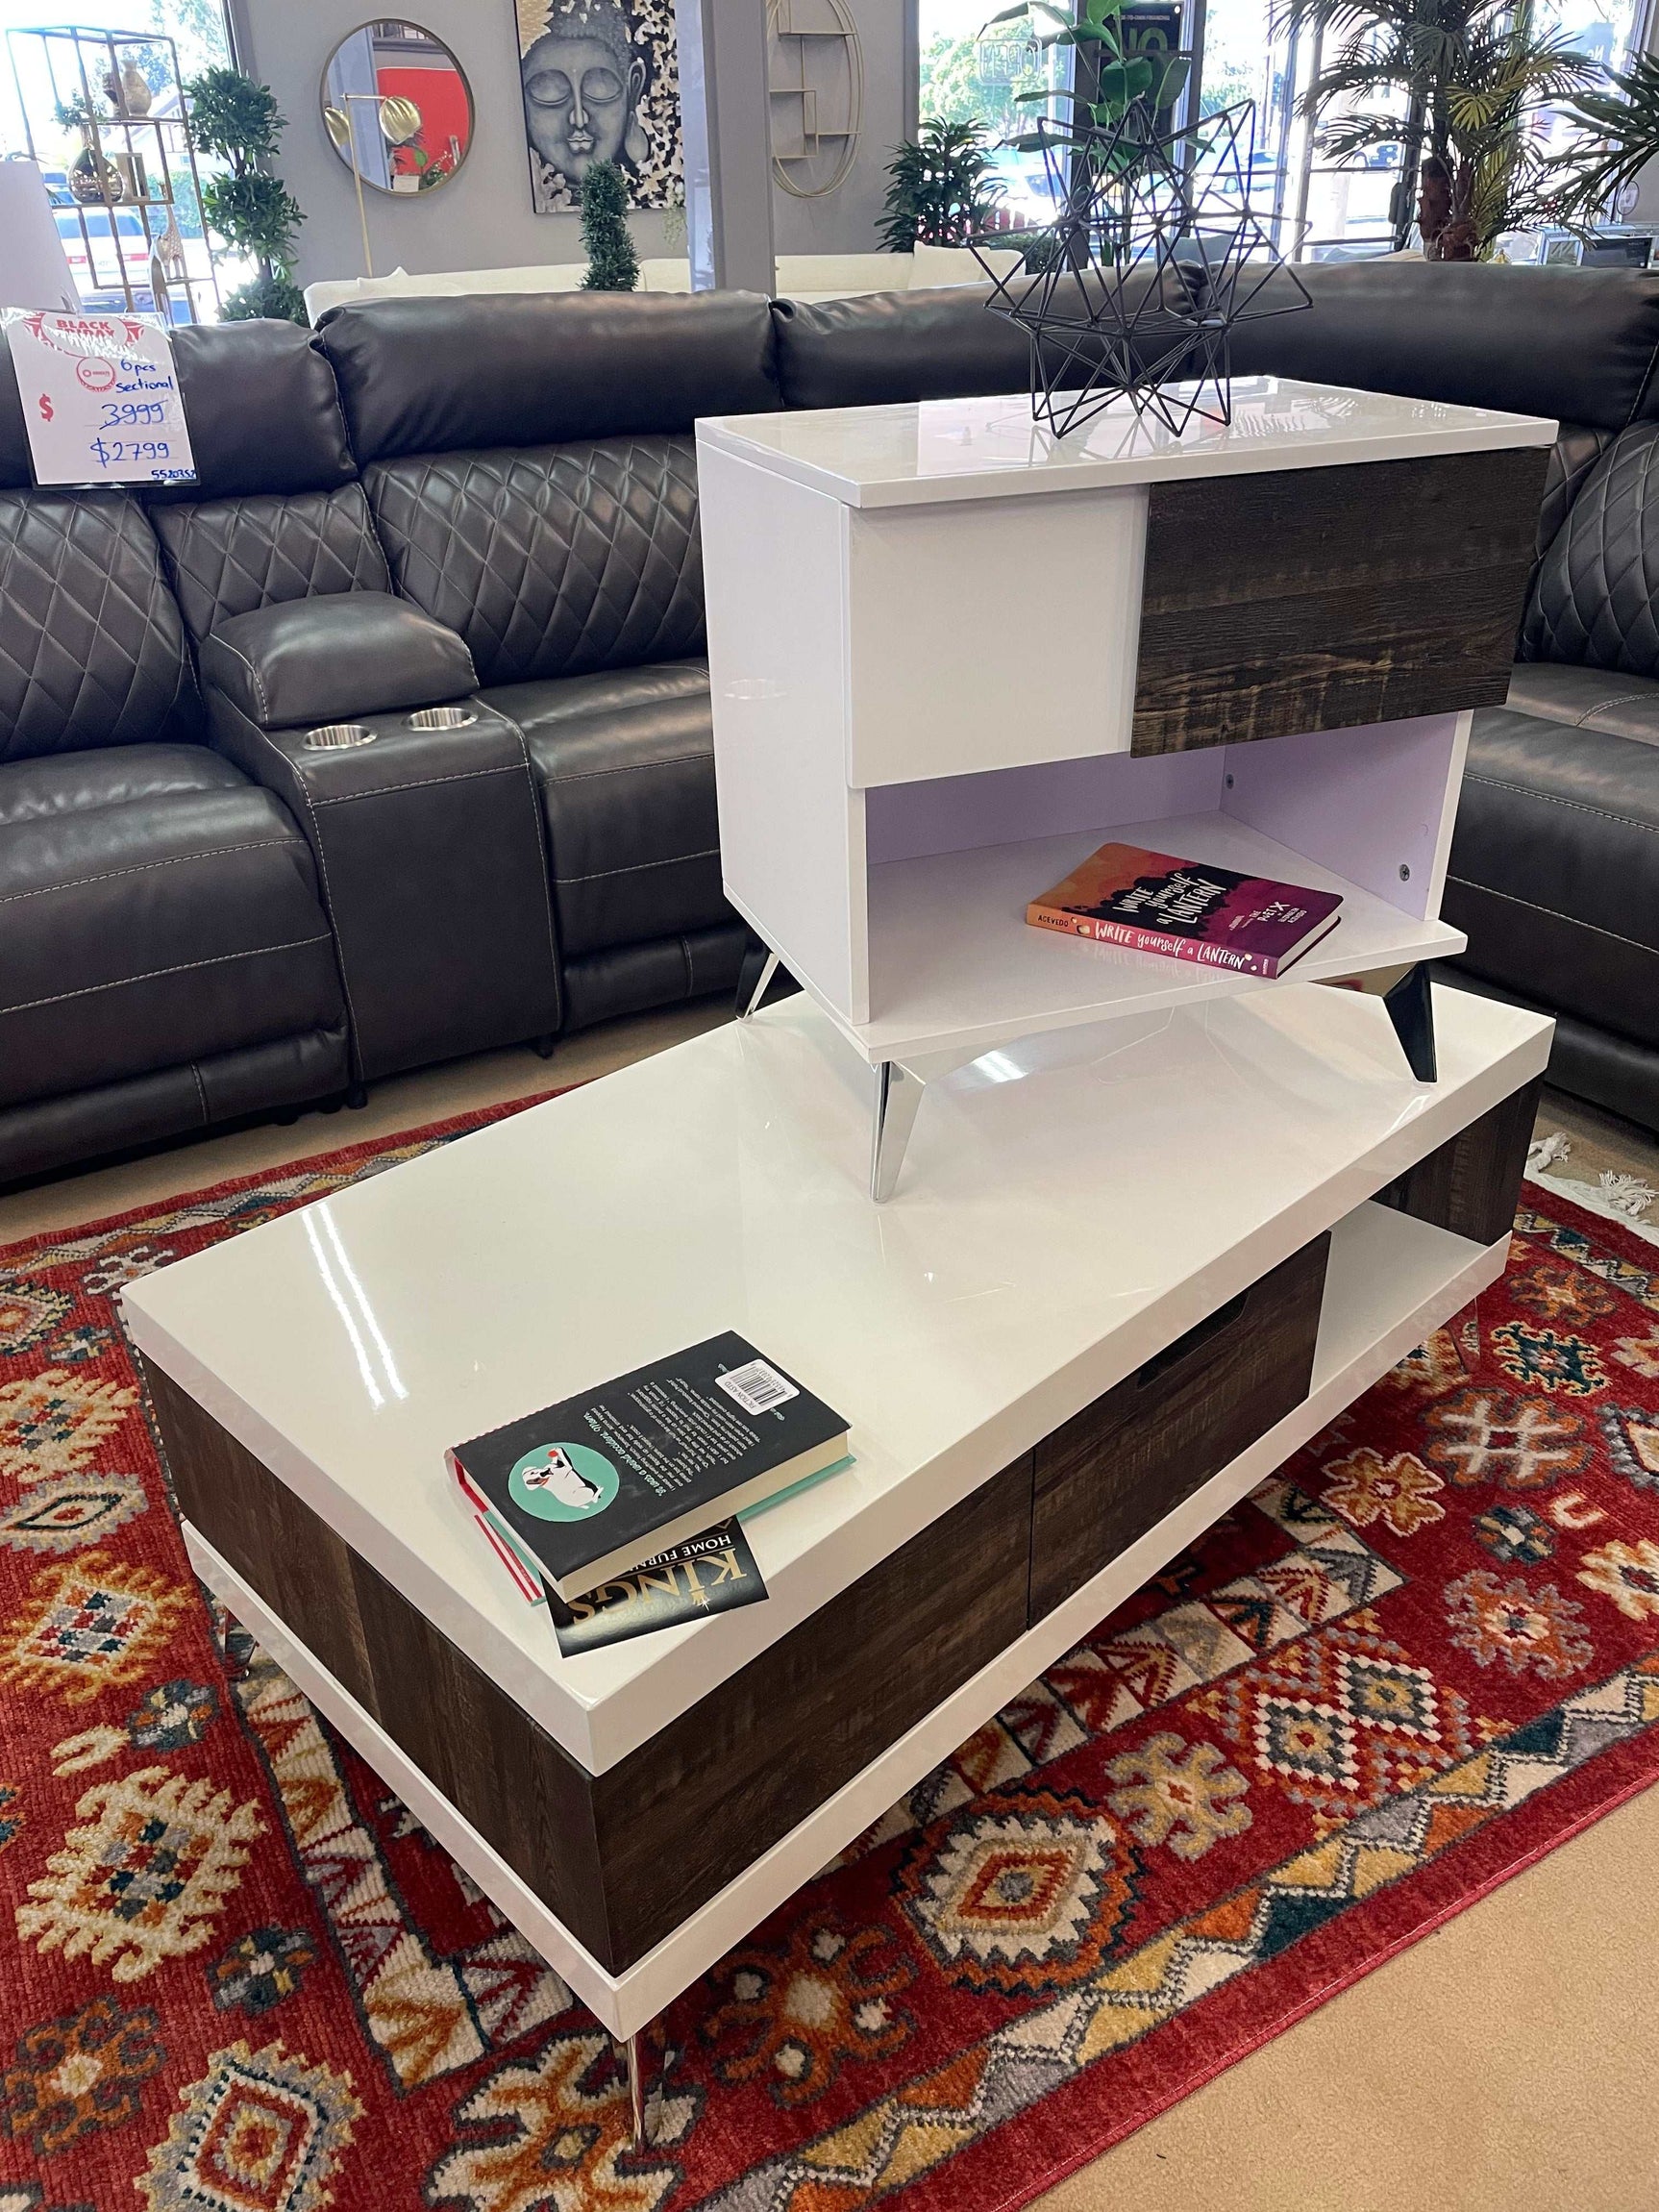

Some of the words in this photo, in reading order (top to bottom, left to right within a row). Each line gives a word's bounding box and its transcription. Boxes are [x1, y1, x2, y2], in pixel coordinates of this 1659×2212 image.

[56, 319, 111, 330] BLACK
[135, 363, 156, 376] pcs
[38, 393, 54, 422] $
[89, 437, 170, 468] $2799
[1111, 886, 1154, 913] WRITE
[1145, 872, 1201, 909] yourself
[1158, 878, 1227, 924] LANTERN
[1037, 914, 1069, 928] ACEVEDO
[1095, 921, 1135, 944] WRITE
[1137, 933, 1186, 957] yourself
[1187, 946, 1194, 955] a
[1197, 943, 1245, 970] LANTERN
[683, 1534, 732, 1557] HOME
[630, 1550, 679, 1573] FURN
[570, 1549, 747, 1625] KINGS
